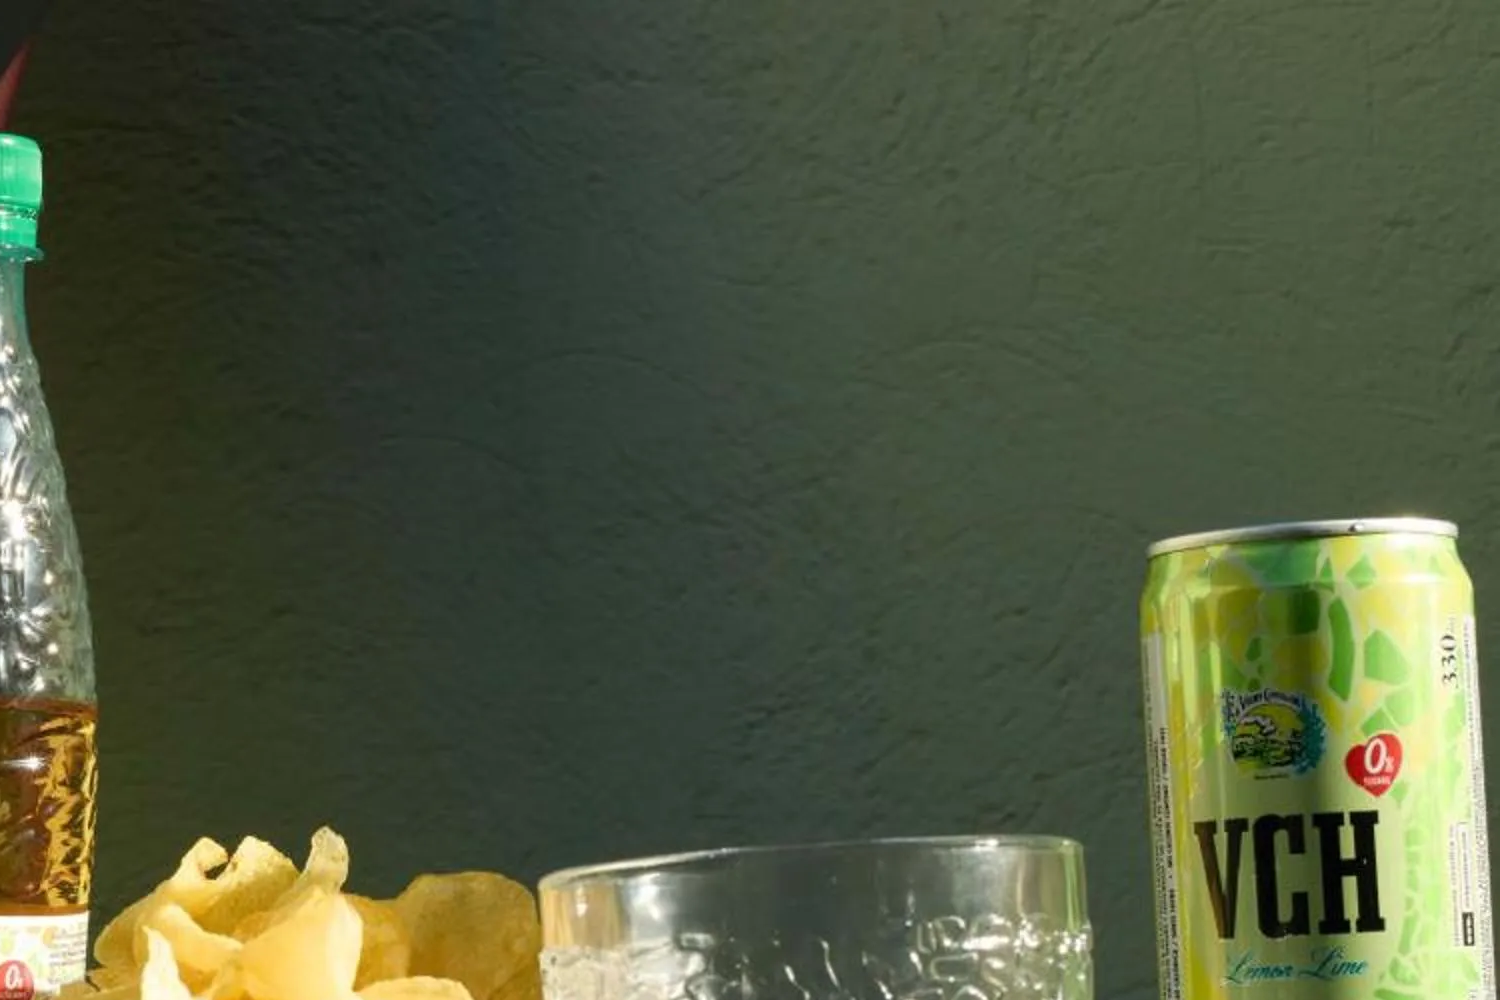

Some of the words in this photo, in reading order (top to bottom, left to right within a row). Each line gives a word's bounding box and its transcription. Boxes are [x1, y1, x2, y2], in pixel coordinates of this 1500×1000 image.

[1440, 635, 1458, 689] 330
[1193, 809, 1386, 940] VCH
[1225, 951, 1294, 984] Lemon
[1301, 945, 1369, 982] Lime
